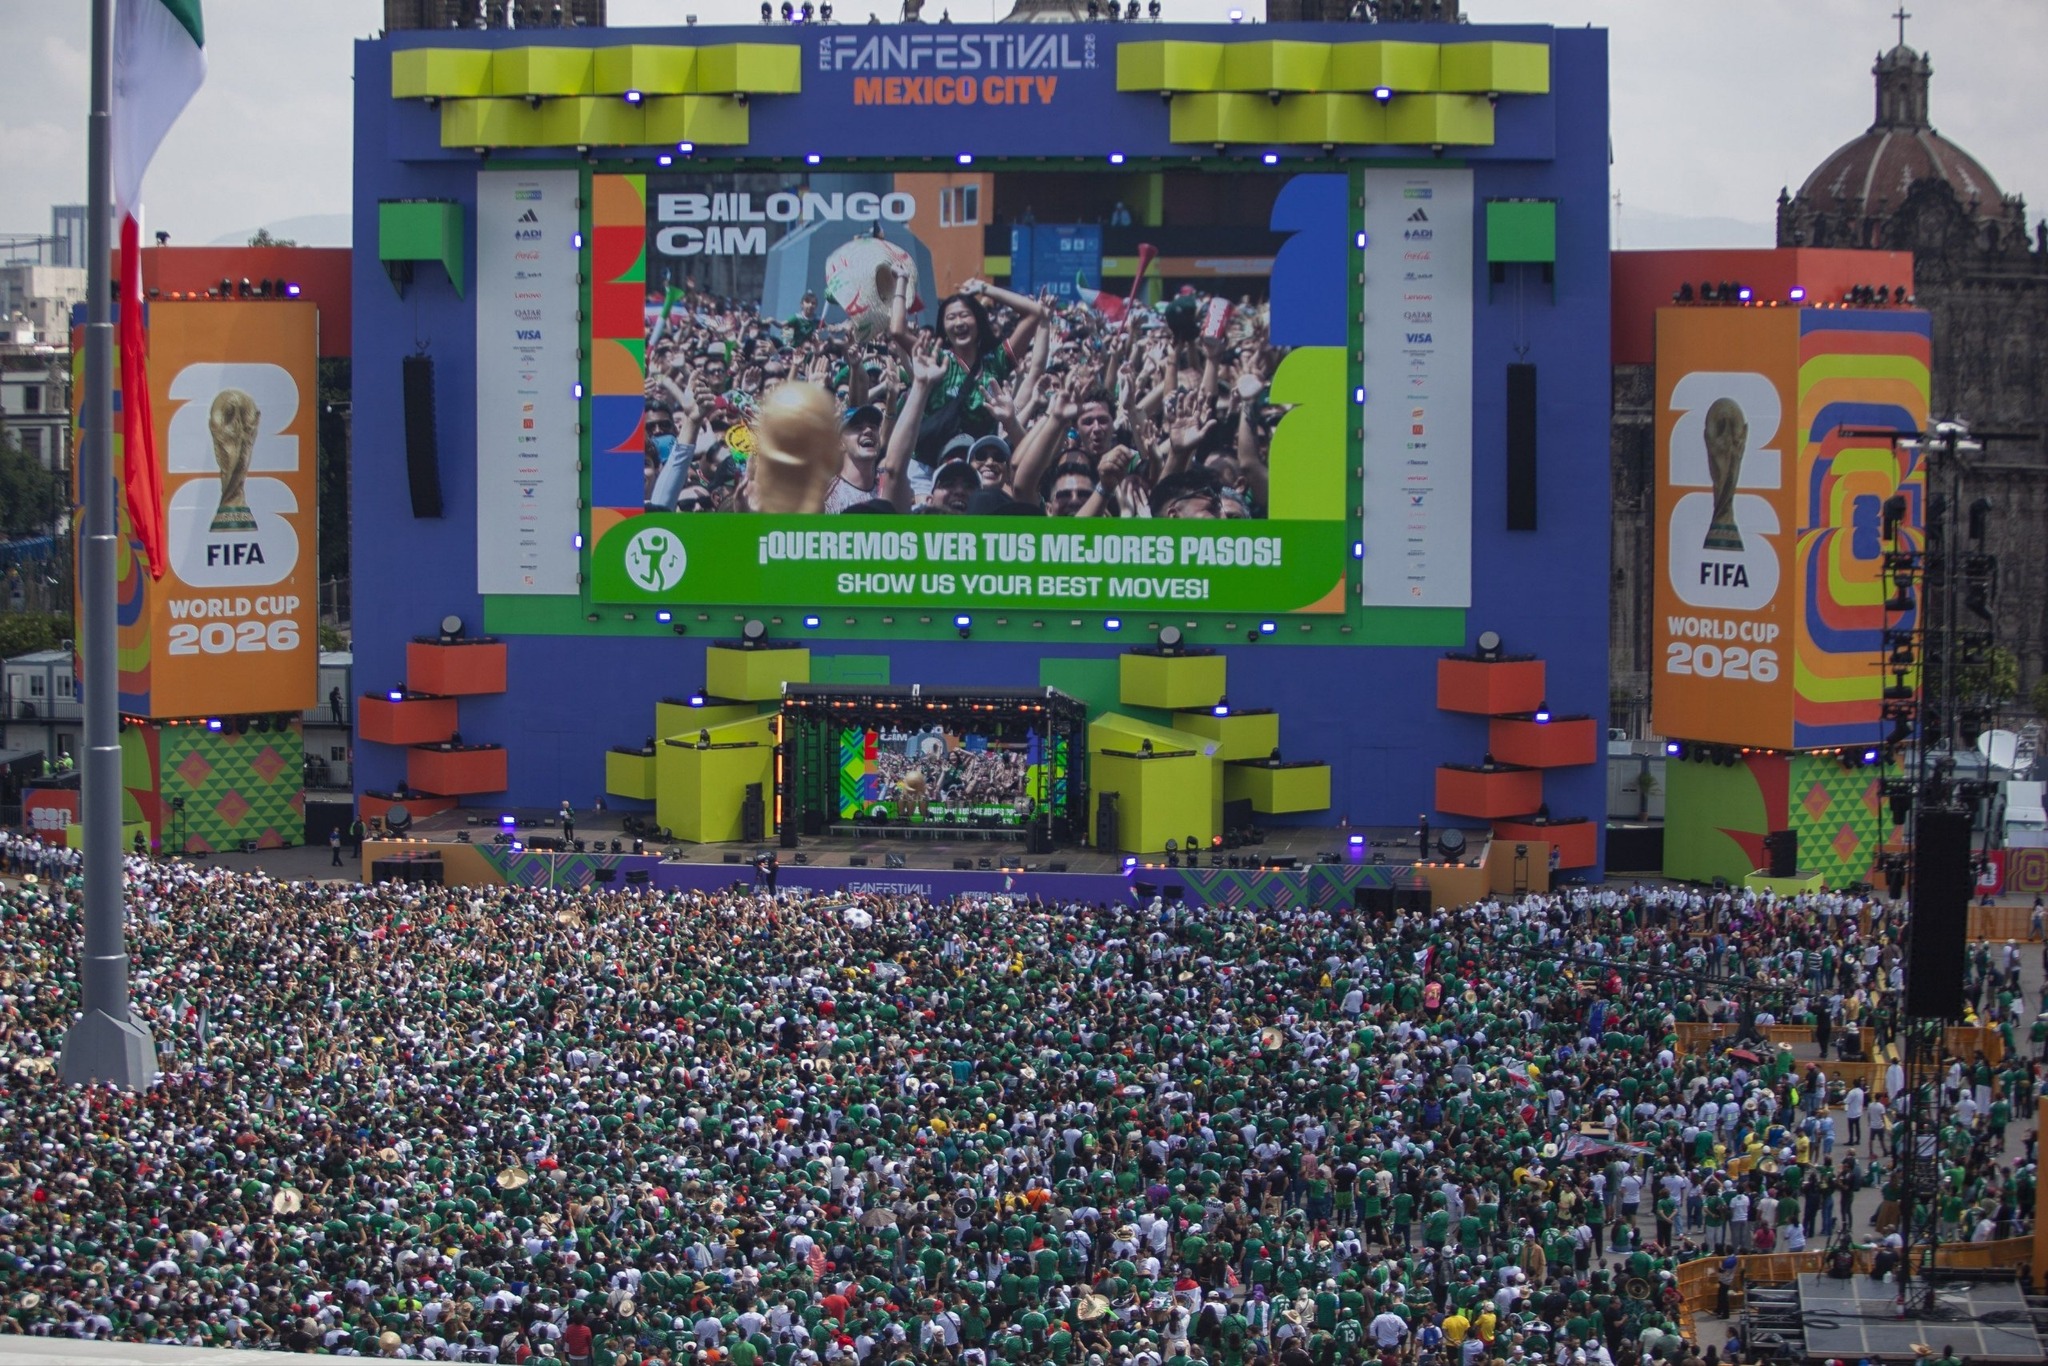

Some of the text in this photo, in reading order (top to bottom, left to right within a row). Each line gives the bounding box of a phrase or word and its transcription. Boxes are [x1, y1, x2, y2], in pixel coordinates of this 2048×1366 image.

[820, 36, 831, 71] FIFA
[854, 76, 1058, 106] MEXICO CITY
[658, 192, 916, 222] BAILONGO
[656, 226, 767, 256] CAM
[514, 309, 541, 318] QATAR
[1403, 311, 1432, 320] QATAR
[516, 330, 542, 340] VISA
[1406, 333, 1433, 343] VISA
[207, 543, 265, 567] FIFA
[759, 531, 1282, 567] ¡QUEREMOS VER TUS MEJORES PASOS!
[837, 573, 1210, 599] SHOW US YOUR BEST MOVES!
[1700, 562, 1749, 588] FIFA
[169, 596, 300, 619] WORLD CUP
[169, 620, 300, 656] 2026
[1667, 616, 1780, 643] WORLD CUP
[1667, 642, 1779, 682] 2026
[1513, 1243, 1520, 1255] 9
[676, 1340, 683, 1351] 8
[1345, 1330, 1356, 1342] 13
